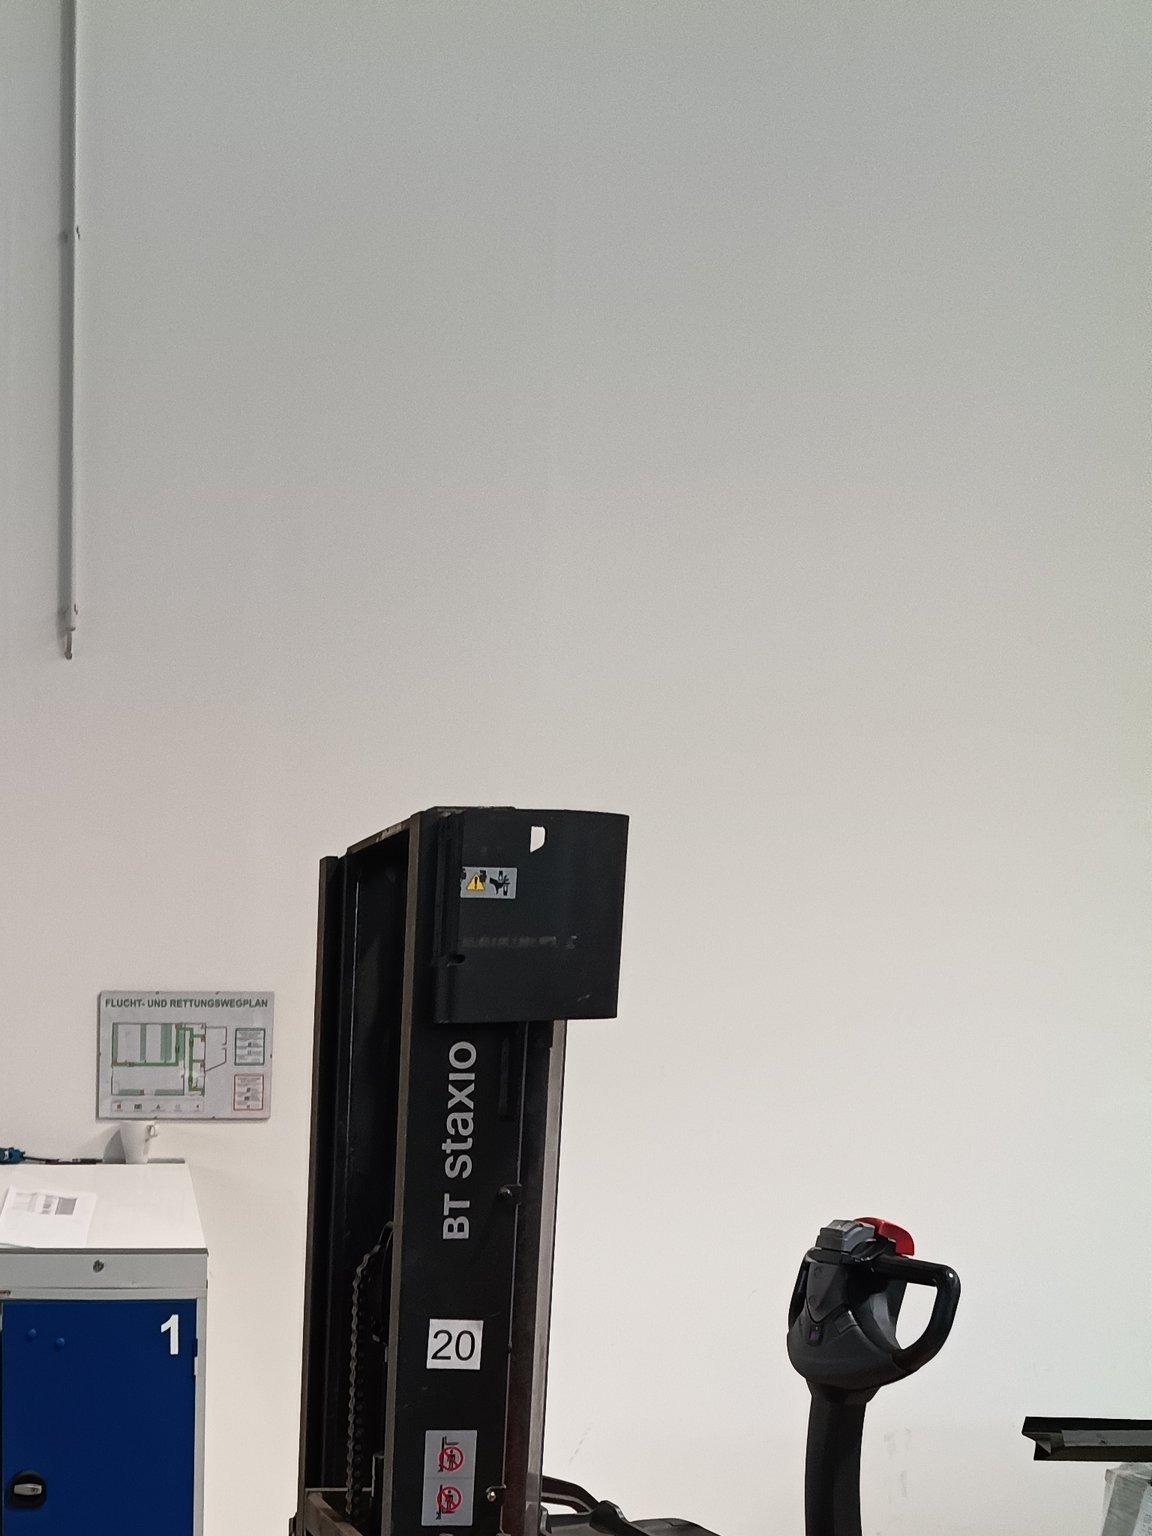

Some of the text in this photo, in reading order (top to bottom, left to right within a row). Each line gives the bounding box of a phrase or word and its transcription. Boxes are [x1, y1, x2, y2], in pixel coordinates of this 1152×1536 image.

[105, 998, 268, 1009] FLUCHT- UND RETTUNGSWEGPLAN
[442, 1193, 471, 1240] BT
[161, 1314, 179, 1355] 1
[430, 1329, 476, 1361] 20
